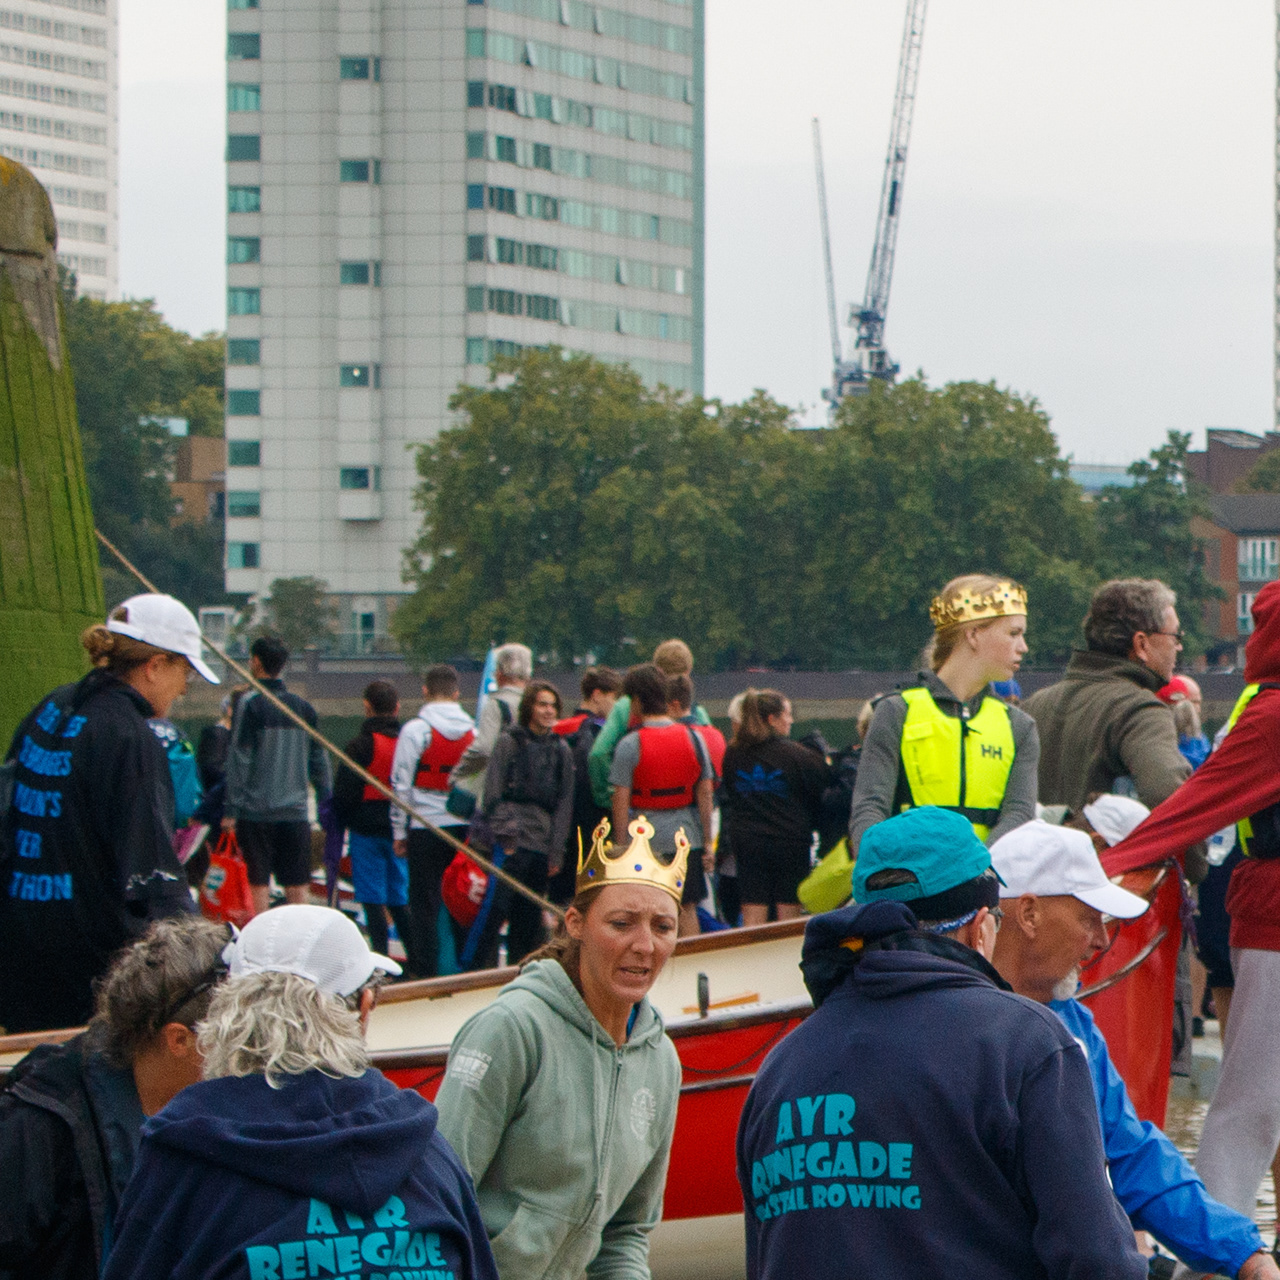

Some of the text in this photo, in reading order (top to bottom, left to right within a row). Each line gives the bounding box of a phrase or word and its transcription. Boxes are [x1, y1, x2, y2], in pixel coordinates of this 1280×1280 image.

[981, 744, 1003, 761] HH
[775, 1092, 856, 1145] AYR
[811, 1183, 922, 1210] ROWING
